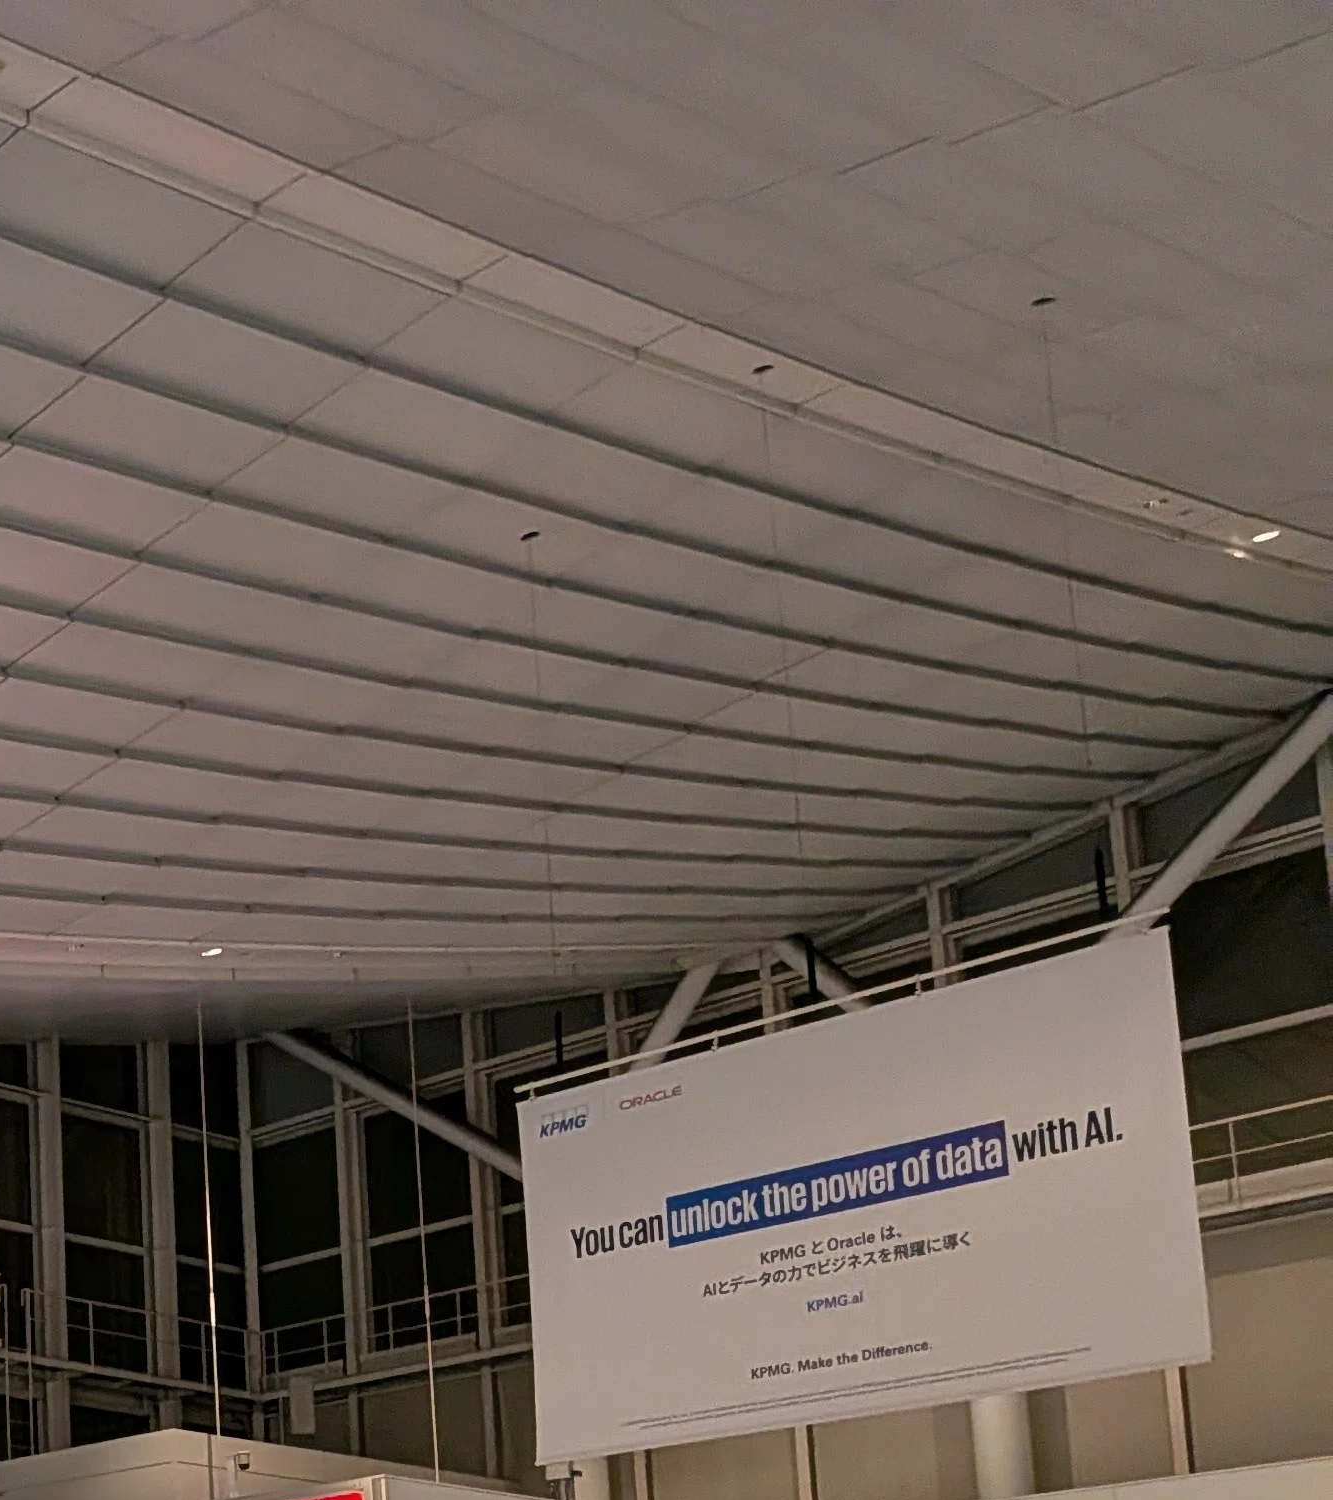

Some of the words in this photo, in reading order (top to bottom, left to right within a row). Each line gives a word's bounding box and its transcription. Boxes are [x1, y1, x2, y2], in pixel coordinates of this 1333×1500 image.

[619, 1085, 682, 1110] ORACLE
[539, 1114, 587, 1138] KPMG
[570, 1225, 615, 1259] You
[619, 1214, 664, 1249] can
[671, 1189, 760, 1239] unlock
[761, 1181, 808, 1218] the
[810, 1160, 897, 1213] power
[901, 1148, 931, 1188] of
[935, 1136, 1003, 1181] data
[1011, 1117, 1079, 1163] with
[1084, 1106, 1124, 1149] AI.
[759, 1244, 806, 1265] KPMG
[811, 1240, 824, 1256] と
[827, 1231, 876, 1252] Oracle
[879, 1225, 903, 1243] は、
[751, 1362, 795, 1380] KPMG.
[798, 1355, 833, 1373] Make
[837, 1352, 859, 1367] the
[861, 1340, 933, 1361] Difference.
